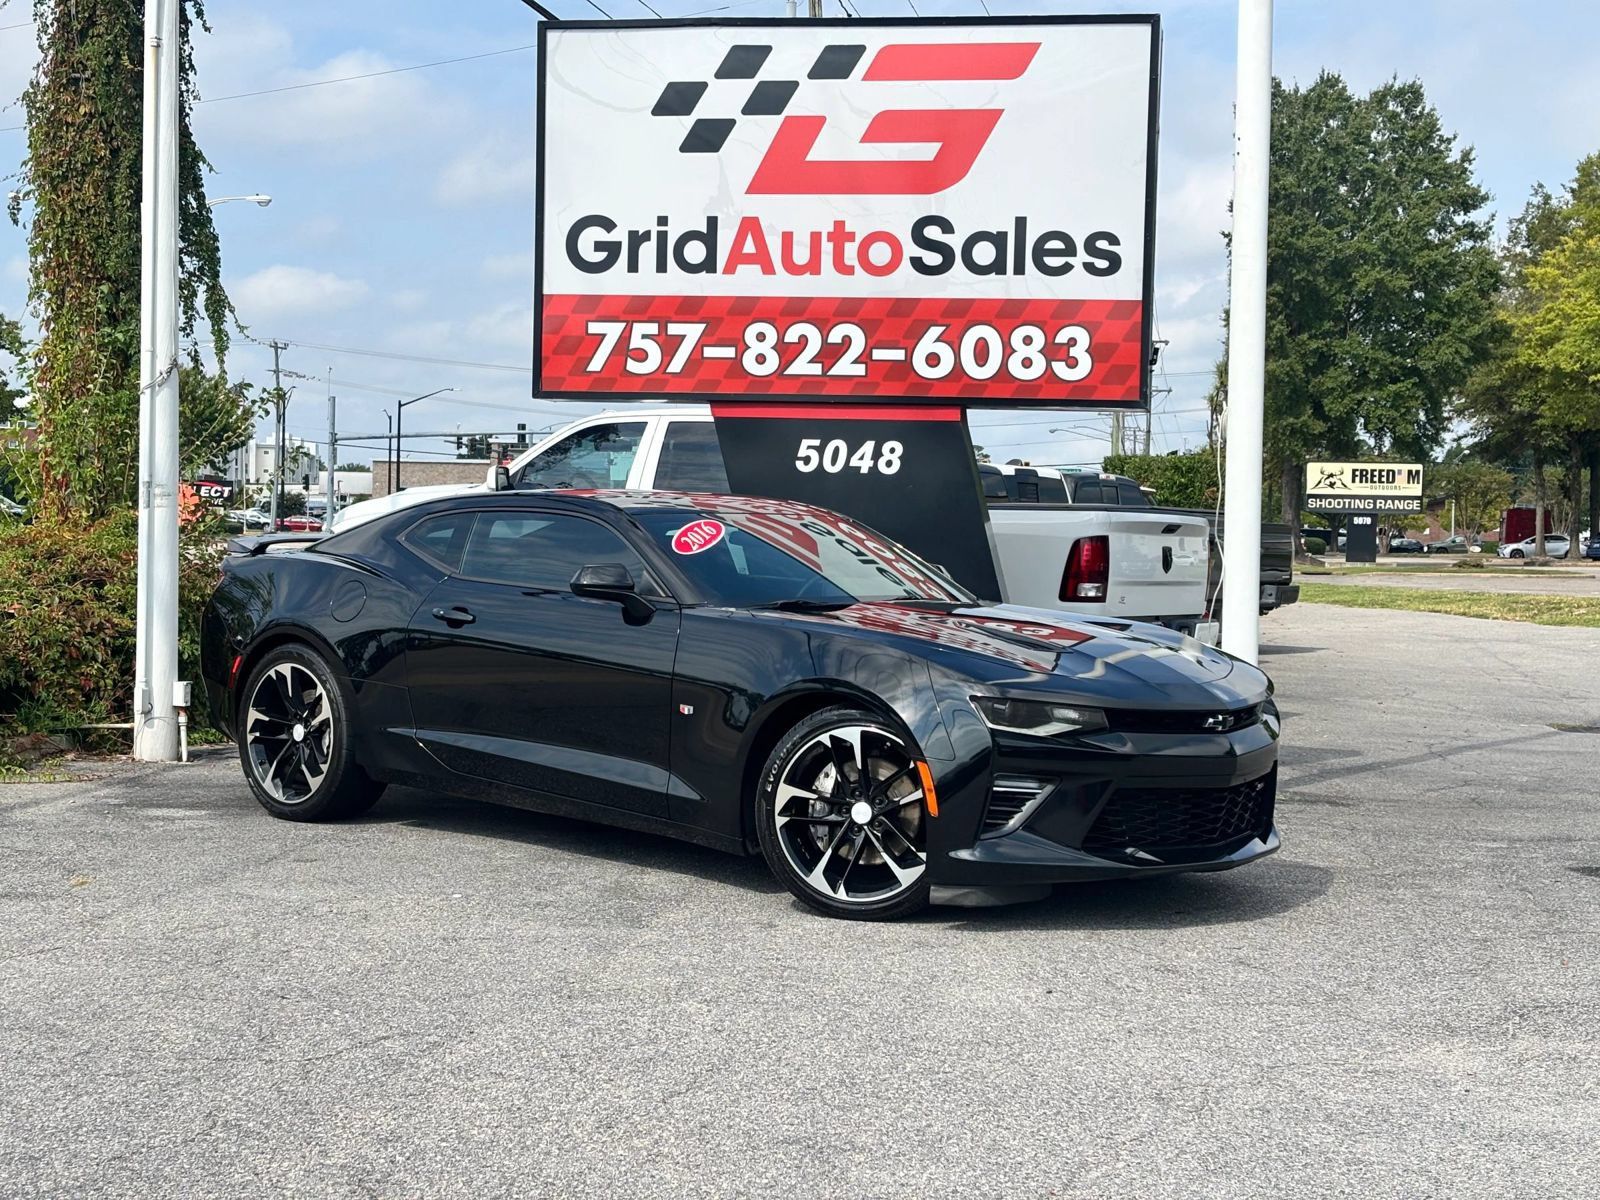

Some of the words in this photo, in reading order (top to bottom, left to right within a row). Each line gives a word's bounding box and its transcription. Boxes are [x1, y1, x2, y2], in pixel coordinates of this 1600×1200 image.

[586, 321, 1093, 381] 757-822-6083
[795, 439, 904, 475] 5048
[1351, 468, 1421, 484] FREEDM
[1307, 498, 1374, 509] SHOOTING
[1376, 499, 1421, 510] RANGE
[680, 521, 717, 551] 2016
